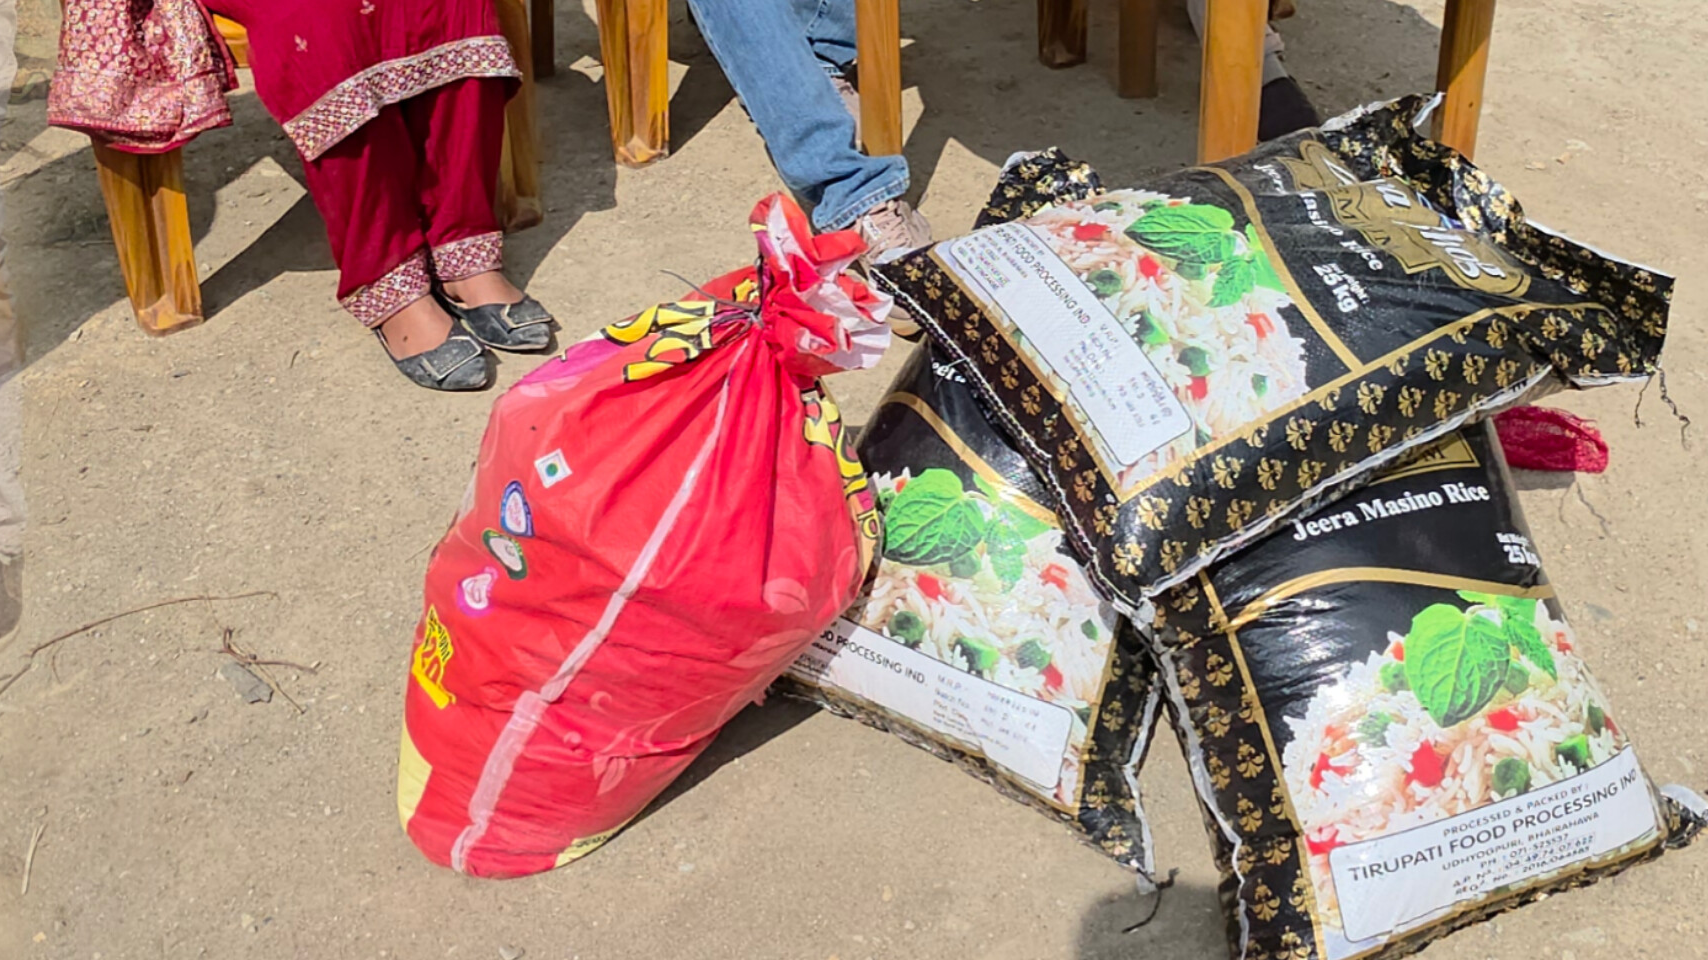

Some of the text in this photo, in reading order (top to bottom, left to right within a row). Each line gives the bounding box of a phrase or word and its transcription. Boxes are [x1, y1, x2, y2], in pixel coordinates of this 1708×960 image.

[1031, 261, 1078, 310] PROCESSING
[1312, 265, 1359, 313] 25 kg
[1293, 482, 1490, 541] Jeera Masino Rice
[1503, 544, 1526, 564] 25
[836, 635, 903, 674] PROCESSING
[1347, 844, 1444, 882] TIRUPATI
[1449, 824, 1507, 853] FOOD
[1512, 781, 1619, 833] PROCESSING
[1442, 807, 1512, 837] PROCESSED
[1526, 789, 1569, 810] PACKED
[1527, 811, 1600, 841] BHAIRAHAWA
